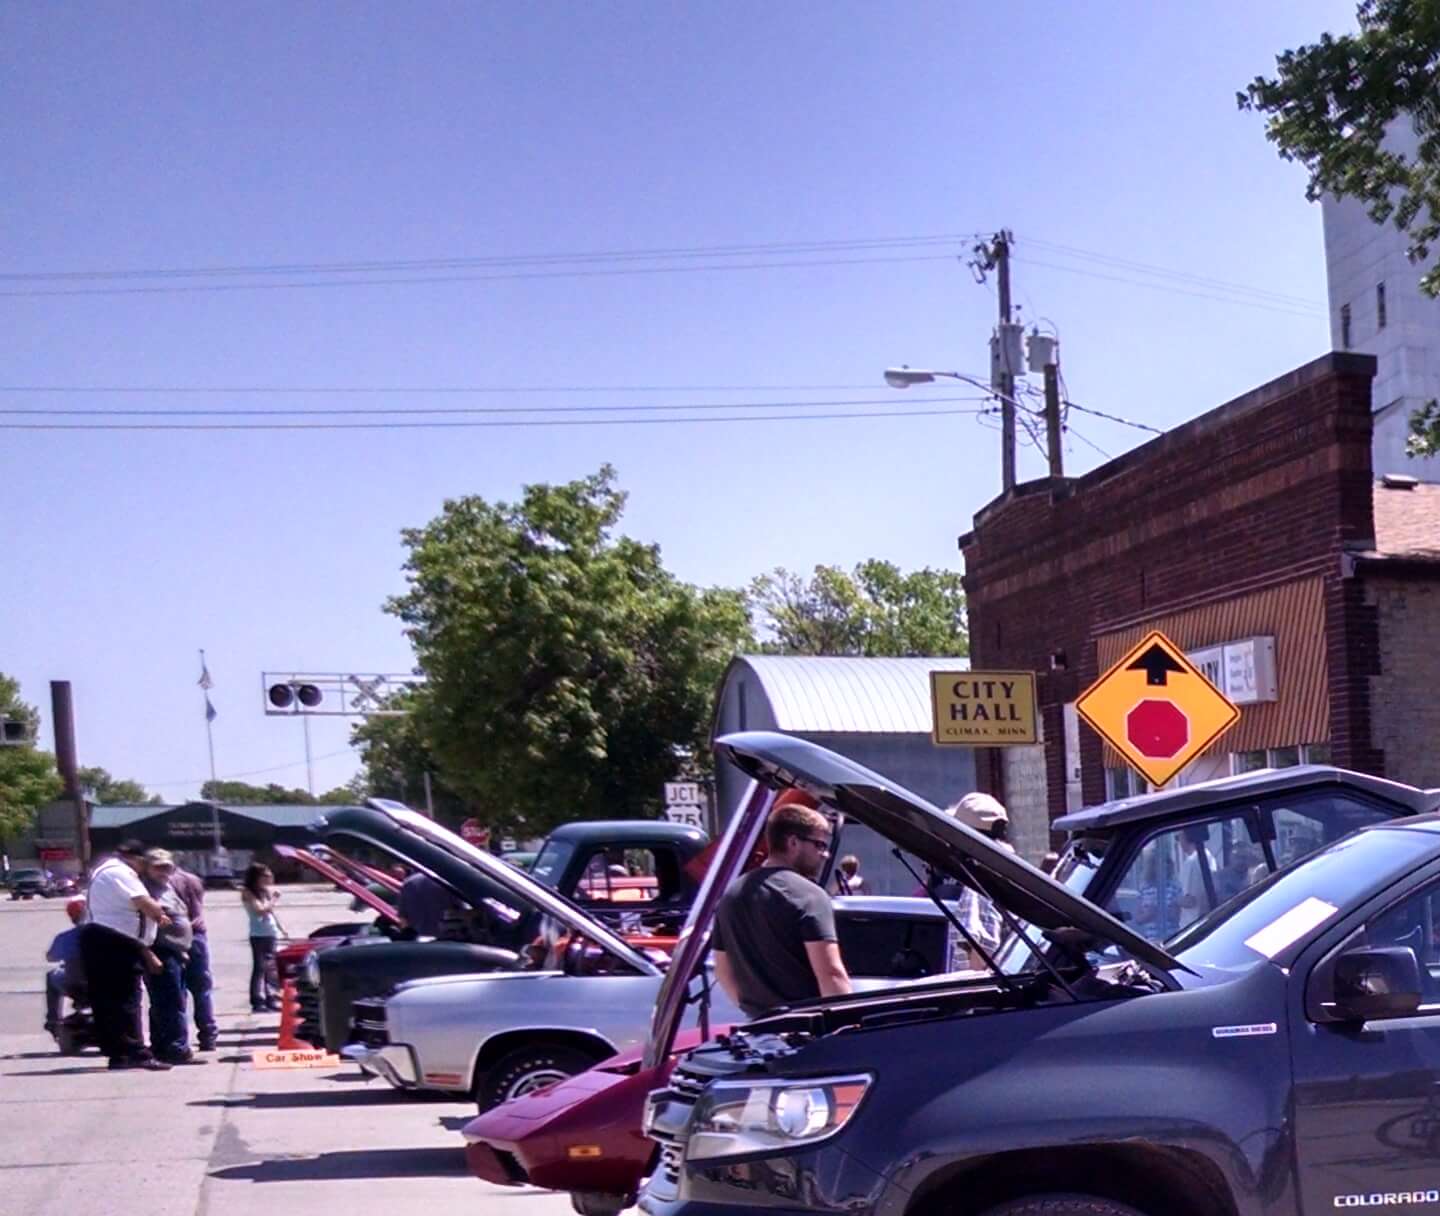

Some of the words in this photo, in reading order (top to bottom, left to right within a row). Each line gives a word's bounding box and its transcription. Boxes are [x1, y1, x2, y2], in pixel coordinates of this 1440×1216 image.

[952, 680, 1015, 699] CITY
[949, 703, 1022, 721] HALL
[670, 786, 695, 801] JCT
[265, 1053, 286, 1063] Car
[291, 1052, 323, 1062] Show
[1334, 1190, 1440, 1208] COLORADO
